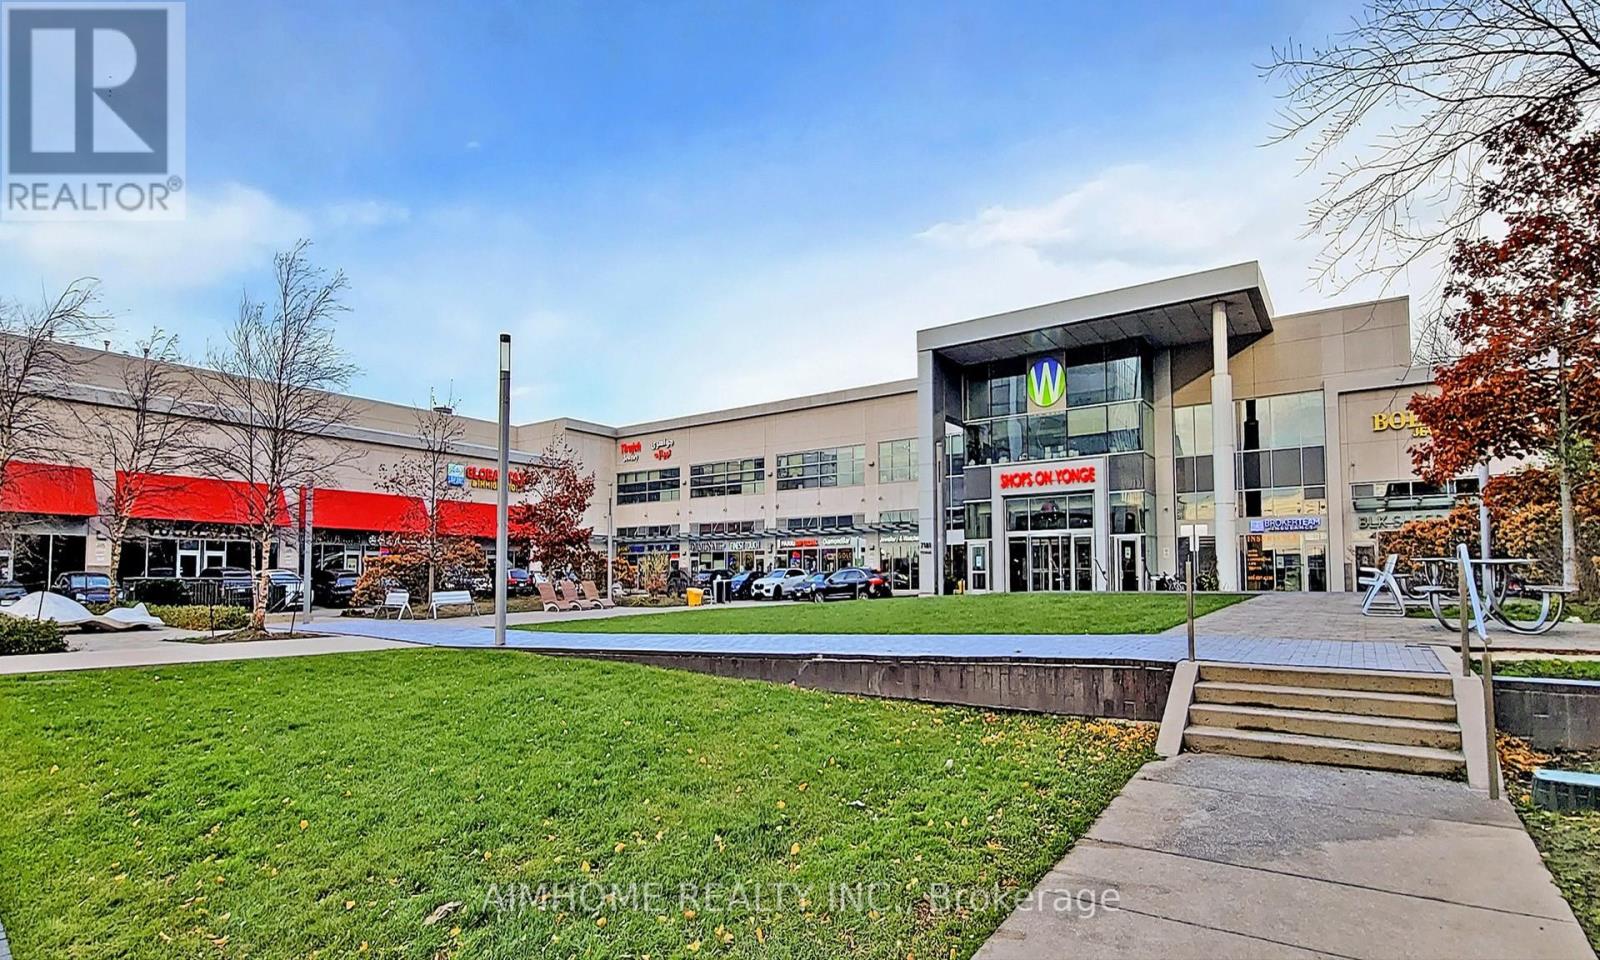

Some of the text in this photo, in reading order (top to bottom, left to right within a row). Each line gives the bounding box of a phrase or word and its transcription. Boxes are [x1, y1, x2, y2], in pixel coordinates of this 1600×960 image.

[1372, 410, 1425, 432] BOL
[465, 466, 499, 481] GLOBA
[1000, 466, 1095, 489] SHOPS ON YONGE
[1358, 515, 1388, 529] BLK
